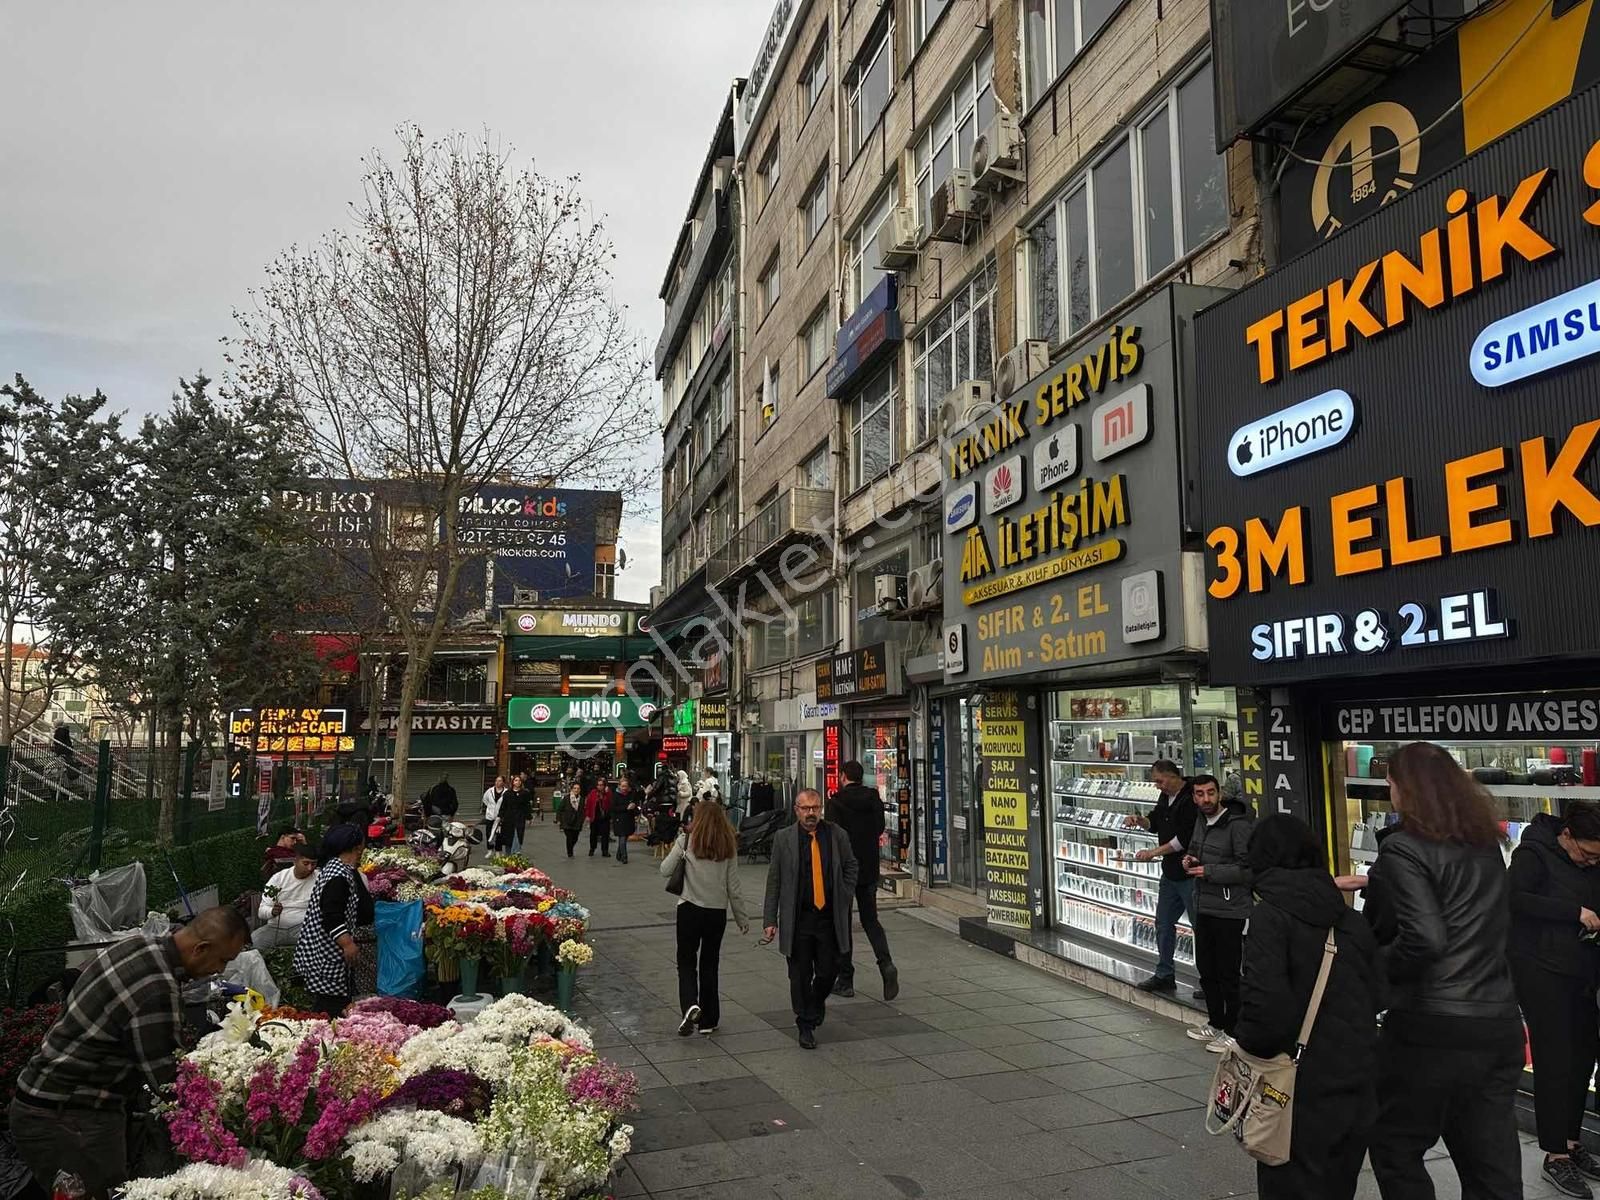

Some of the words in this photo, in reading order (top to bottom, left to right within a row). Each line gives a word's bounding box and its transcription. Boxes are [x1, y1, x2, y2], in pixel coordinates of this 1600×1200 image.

[1350, 179, 1377, 204] 1984
[1036, 325, 1142, 426] SERVİS
[949, 400, 1026, 480] TEKNİK
[1259, 408, 1343, 458] iPhone
[1040, 457, 1069, 485] iPhone
[523, 496, 567, 517] kids
[993, 496, 1013, 509] HUAWEI
[999, 473, 1127, 568] İLETİŞİM
[549, 534, 566, 546] 45
[1206, 505, 1305, 599] 3M
[973, 577, 1014, 601] AKSESUAR
[1016, 575, 1024, 587] &
[562, 614, 621, 627] MUNDO
[977, 604, 1025, 641] SIFIR
[1031, 606, 1045, 629] &
[1050, 594, 1070, 625] 2.
[1078, 583, 1110, 618] EL
[1251, 614, 1345, 662] SIFIR
[1353, 610, 1389, 652] &
[1039, 629, 1106, 664] Satım
[836, 657, 852, 677] HMF
[569, 701, 622, 719] MUNDO
[701, 703, 725, 716] PAŞALAR
[985, 704, 1018, 717] SERVİS
[1338, 708, 1374, 735] CEP
[1380, 704, 1499, 734] TELEFONU
[1506, 700, 1600, 732] AKSES
[308, 721, 342, 735] CAFE
[987, 725, 1018, 736] EKRAN
[983, 742, 1022, 753] KORUYUCU
[991, 760, 1015, 774] ŞARJ
[988, 775, 1020, 790] CİHAZI
[991, 796, 1017, 809] NANO
[995, 814, 1015, 827] CAM
[985, 832, 1026, 847] KULAKLIK
[986, 851, 1027, 867] BATARYA
[987, 870, 1028, 886] ORJİNAL
[989, 888, 1027, 905] AKSESUAR
[987, 907, 1030, 925] POWERBANK
